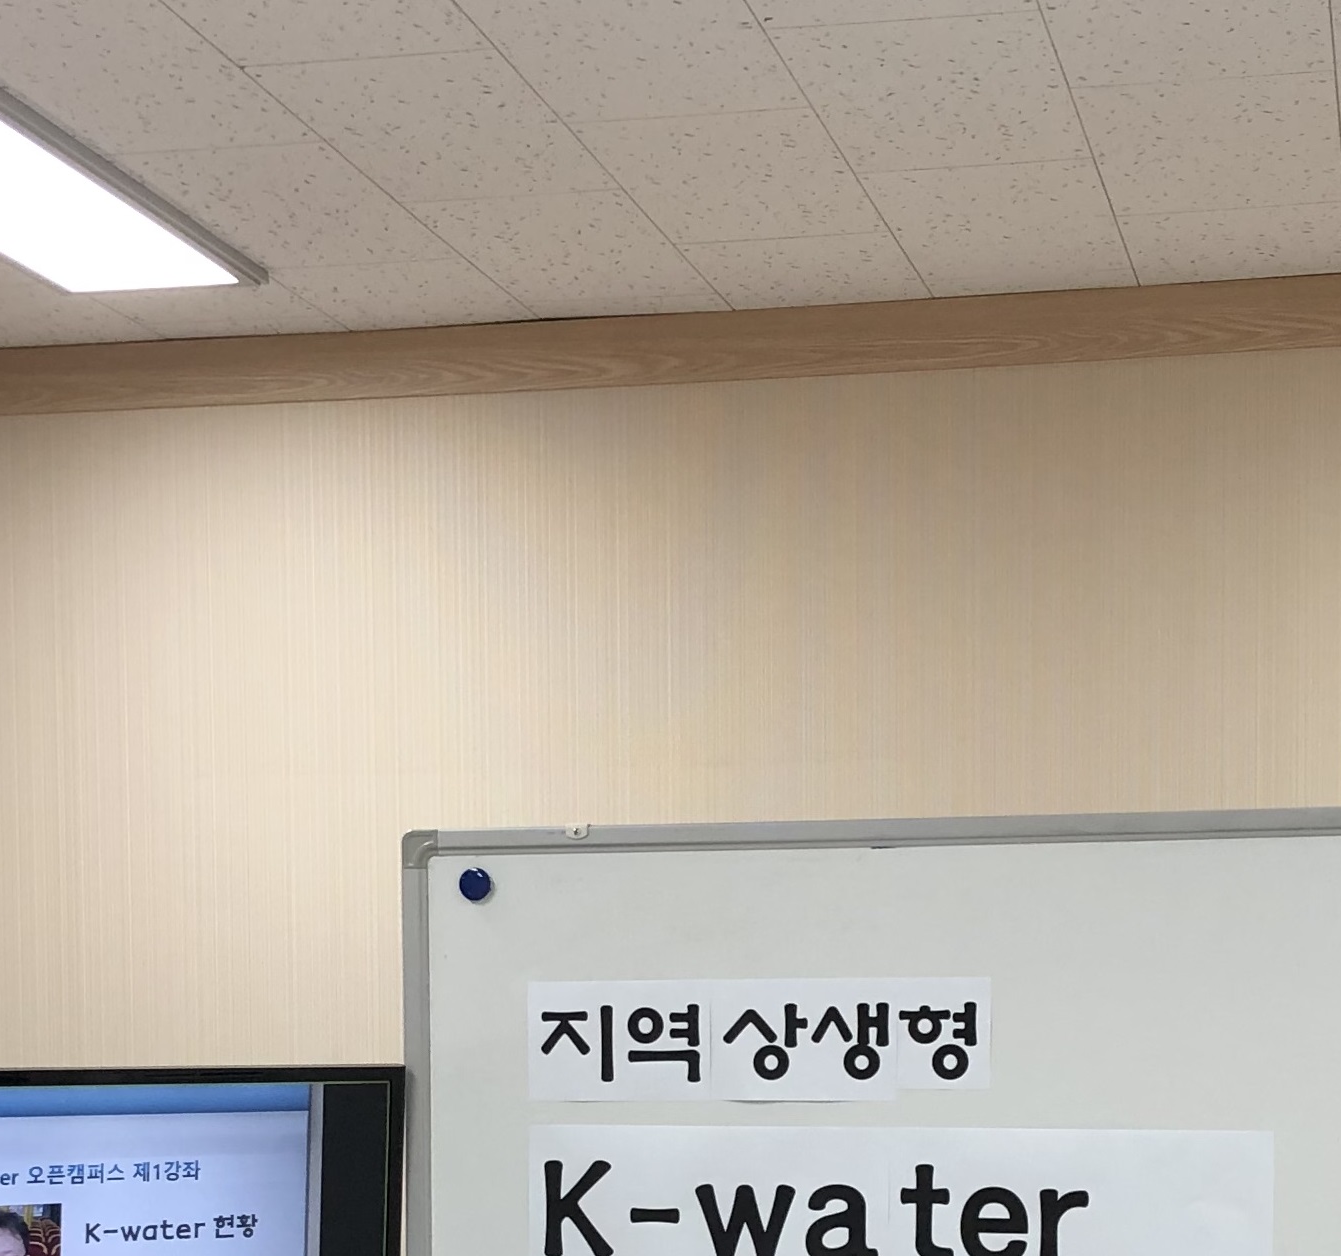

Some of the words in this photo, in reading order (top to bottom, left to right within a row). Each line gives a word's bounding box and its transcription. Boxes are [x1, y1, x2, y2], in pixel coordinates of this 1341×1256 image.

[541, 1003, 701, 1082] 지역
[723, 1002, 978, 1081] 상생형
[26, 1163, 126, 1186] 오픈캠퍼스
[133, 1160, 201, 1183] 제1강좌
[84, 1218, 206, 1244] K-water
[212, 1213, 259, 1239] 현황
